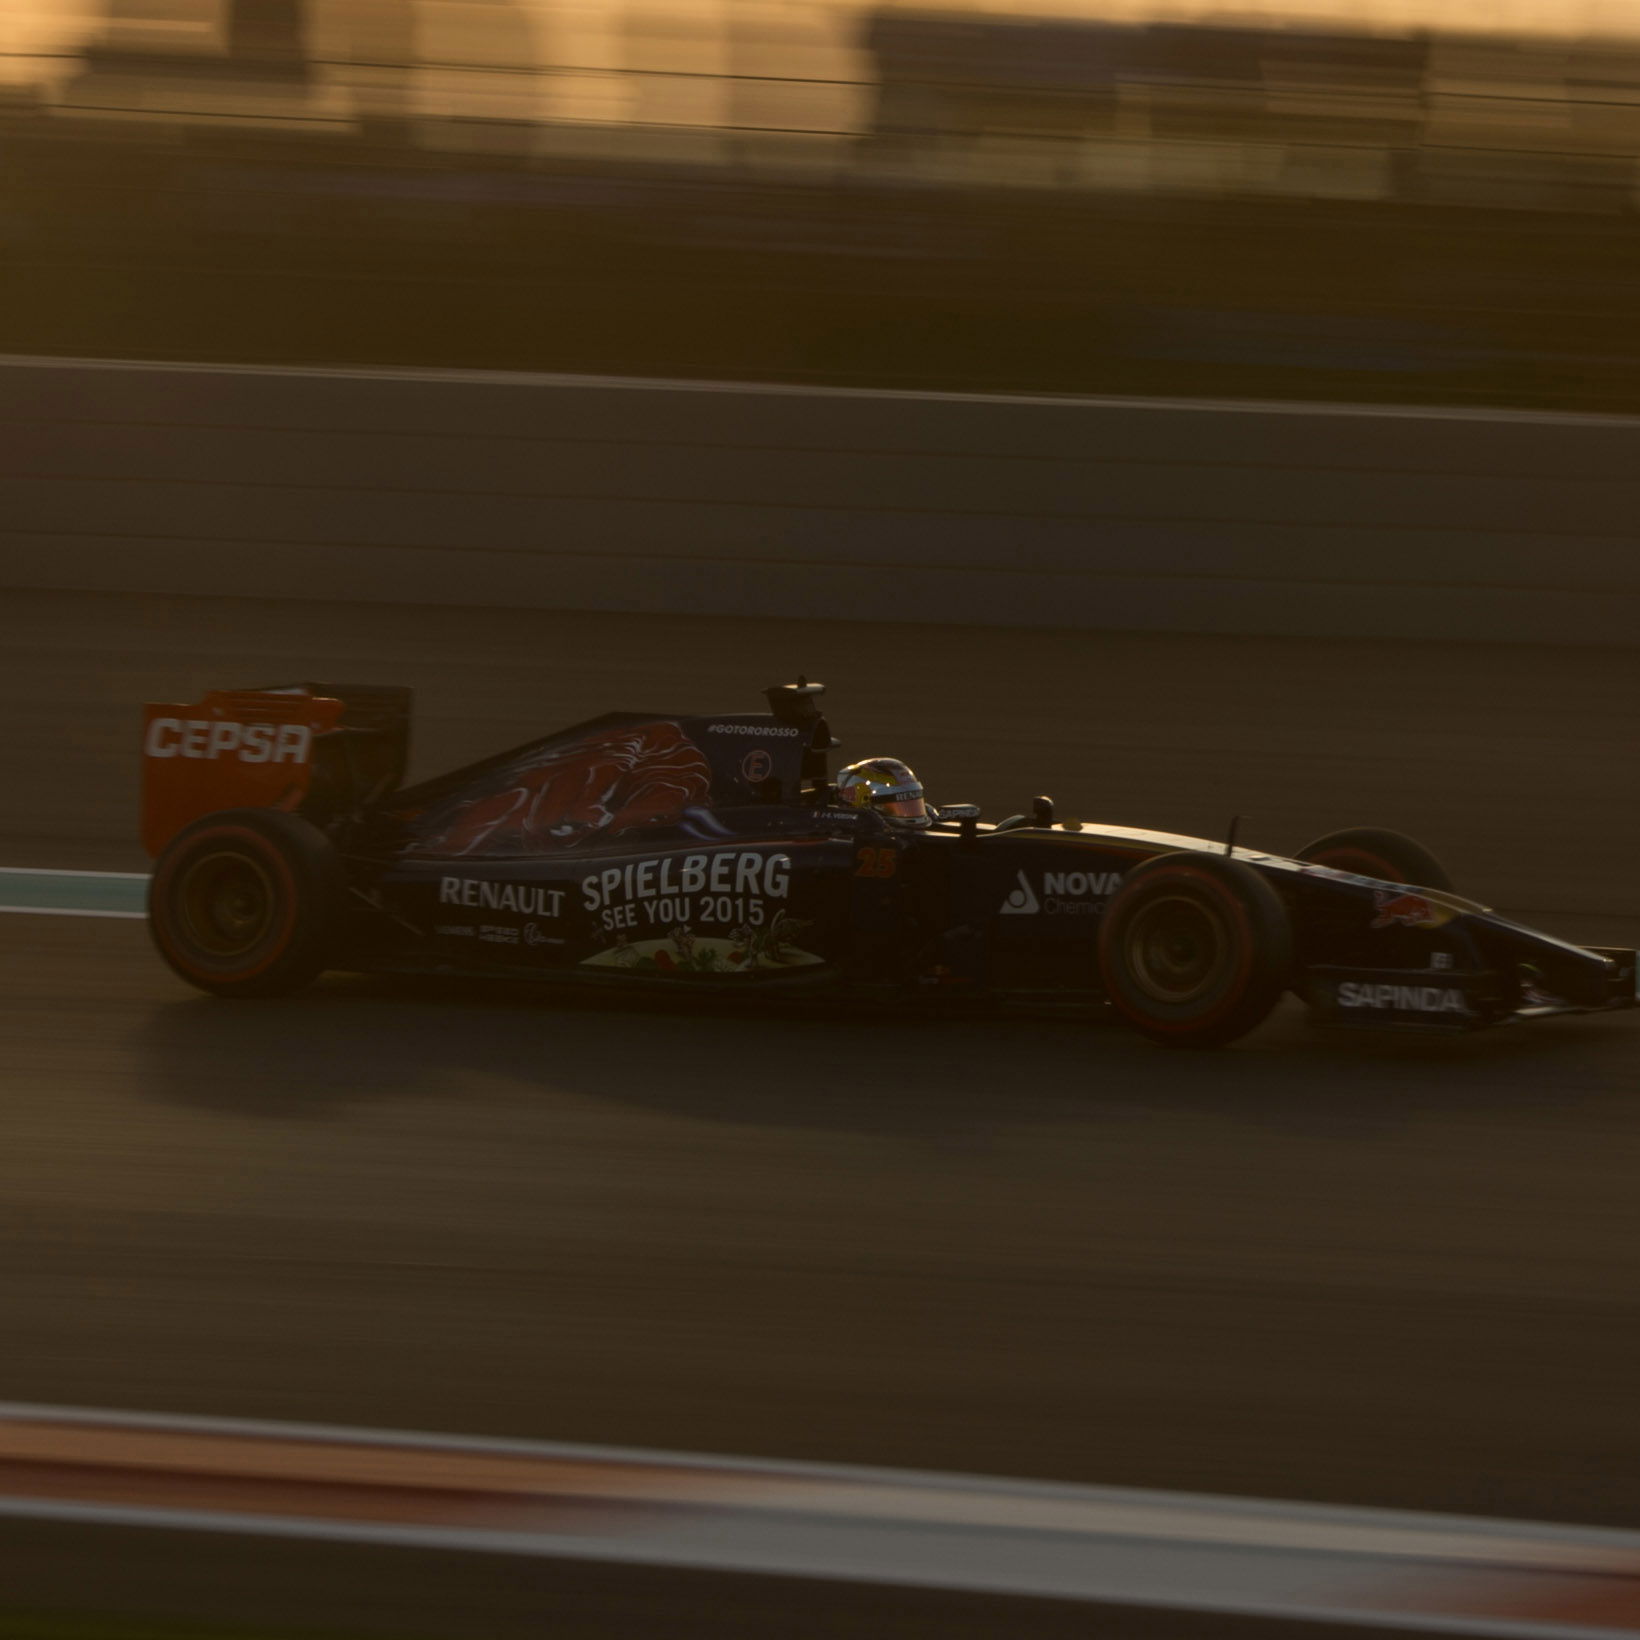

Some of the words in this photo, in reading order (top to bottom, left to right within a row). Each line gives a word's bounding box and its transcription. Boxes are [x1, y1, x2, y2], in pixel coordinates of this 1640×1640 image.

[145, 716, 312, 764] CEPSA
[439, 876, 566, 919] RENAULT
[581, 851, 793, 912] SPIELBERG
[1043, 871, 1123, 896] NOVA
[602, 905, 638, 931] SEE
[643, 897, 691, 924] YOU
[700, 895, 765, 927] 2015
[1337, 981, 1468, 1012] SAPINDA
